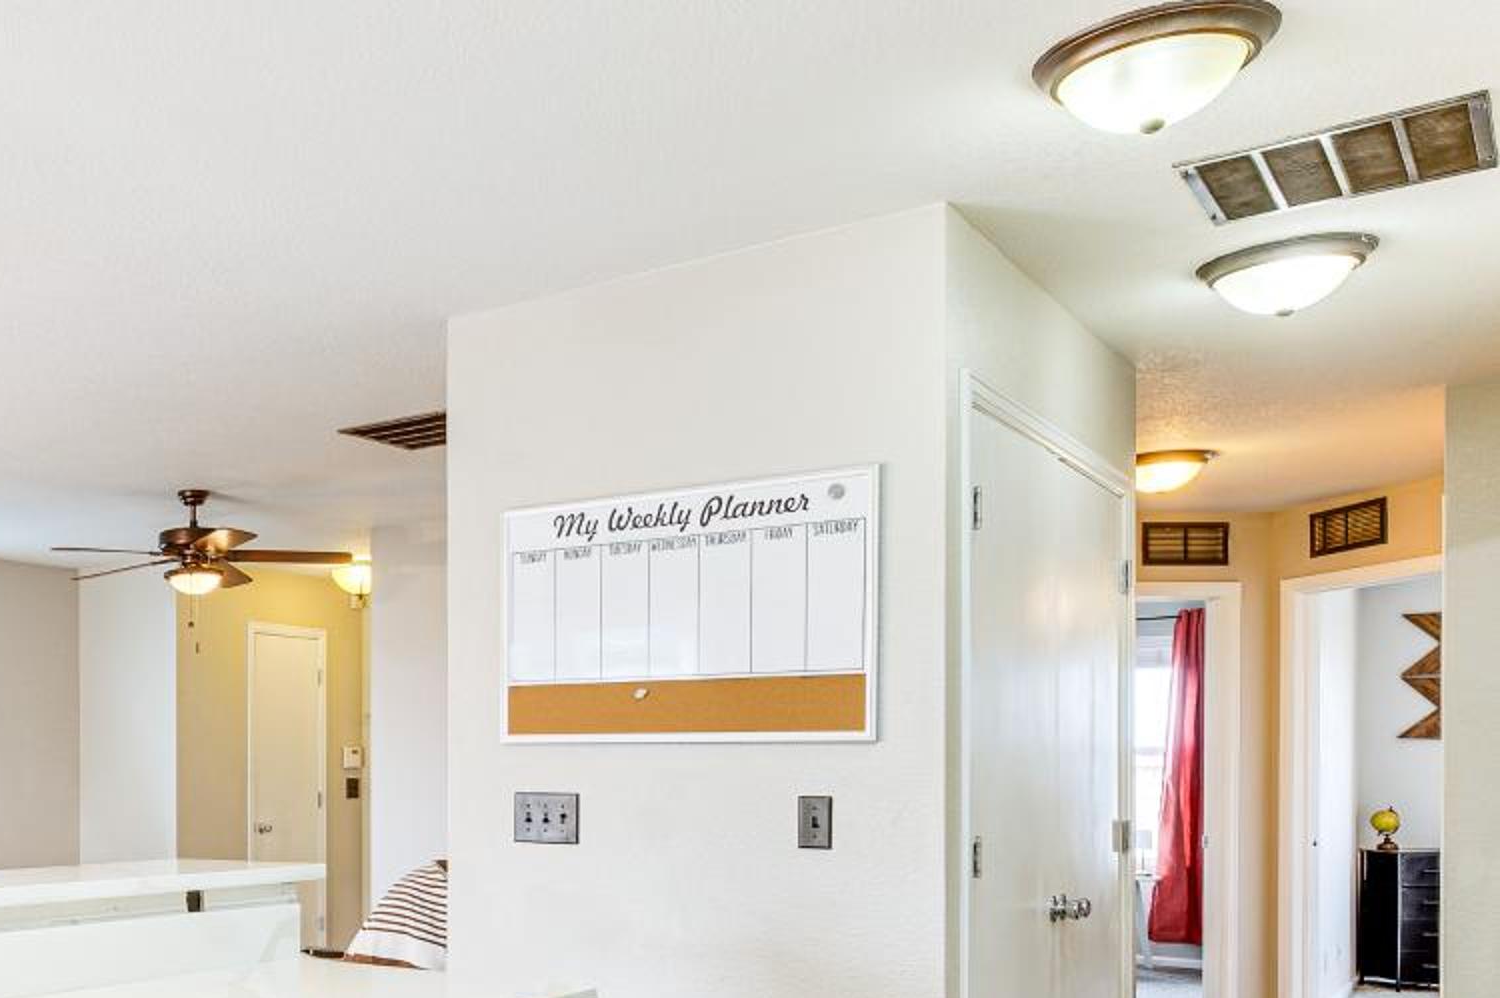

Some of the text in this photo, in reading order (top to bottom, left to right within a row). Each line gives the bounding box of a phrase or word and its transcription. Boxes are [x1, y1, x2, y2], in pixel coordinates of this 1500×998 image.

[553, 493, 810, 541] My Weekly Planner
[764, 527, 793, 541] FRIDAY
[814, 519, 859, 537] SATURDAY
